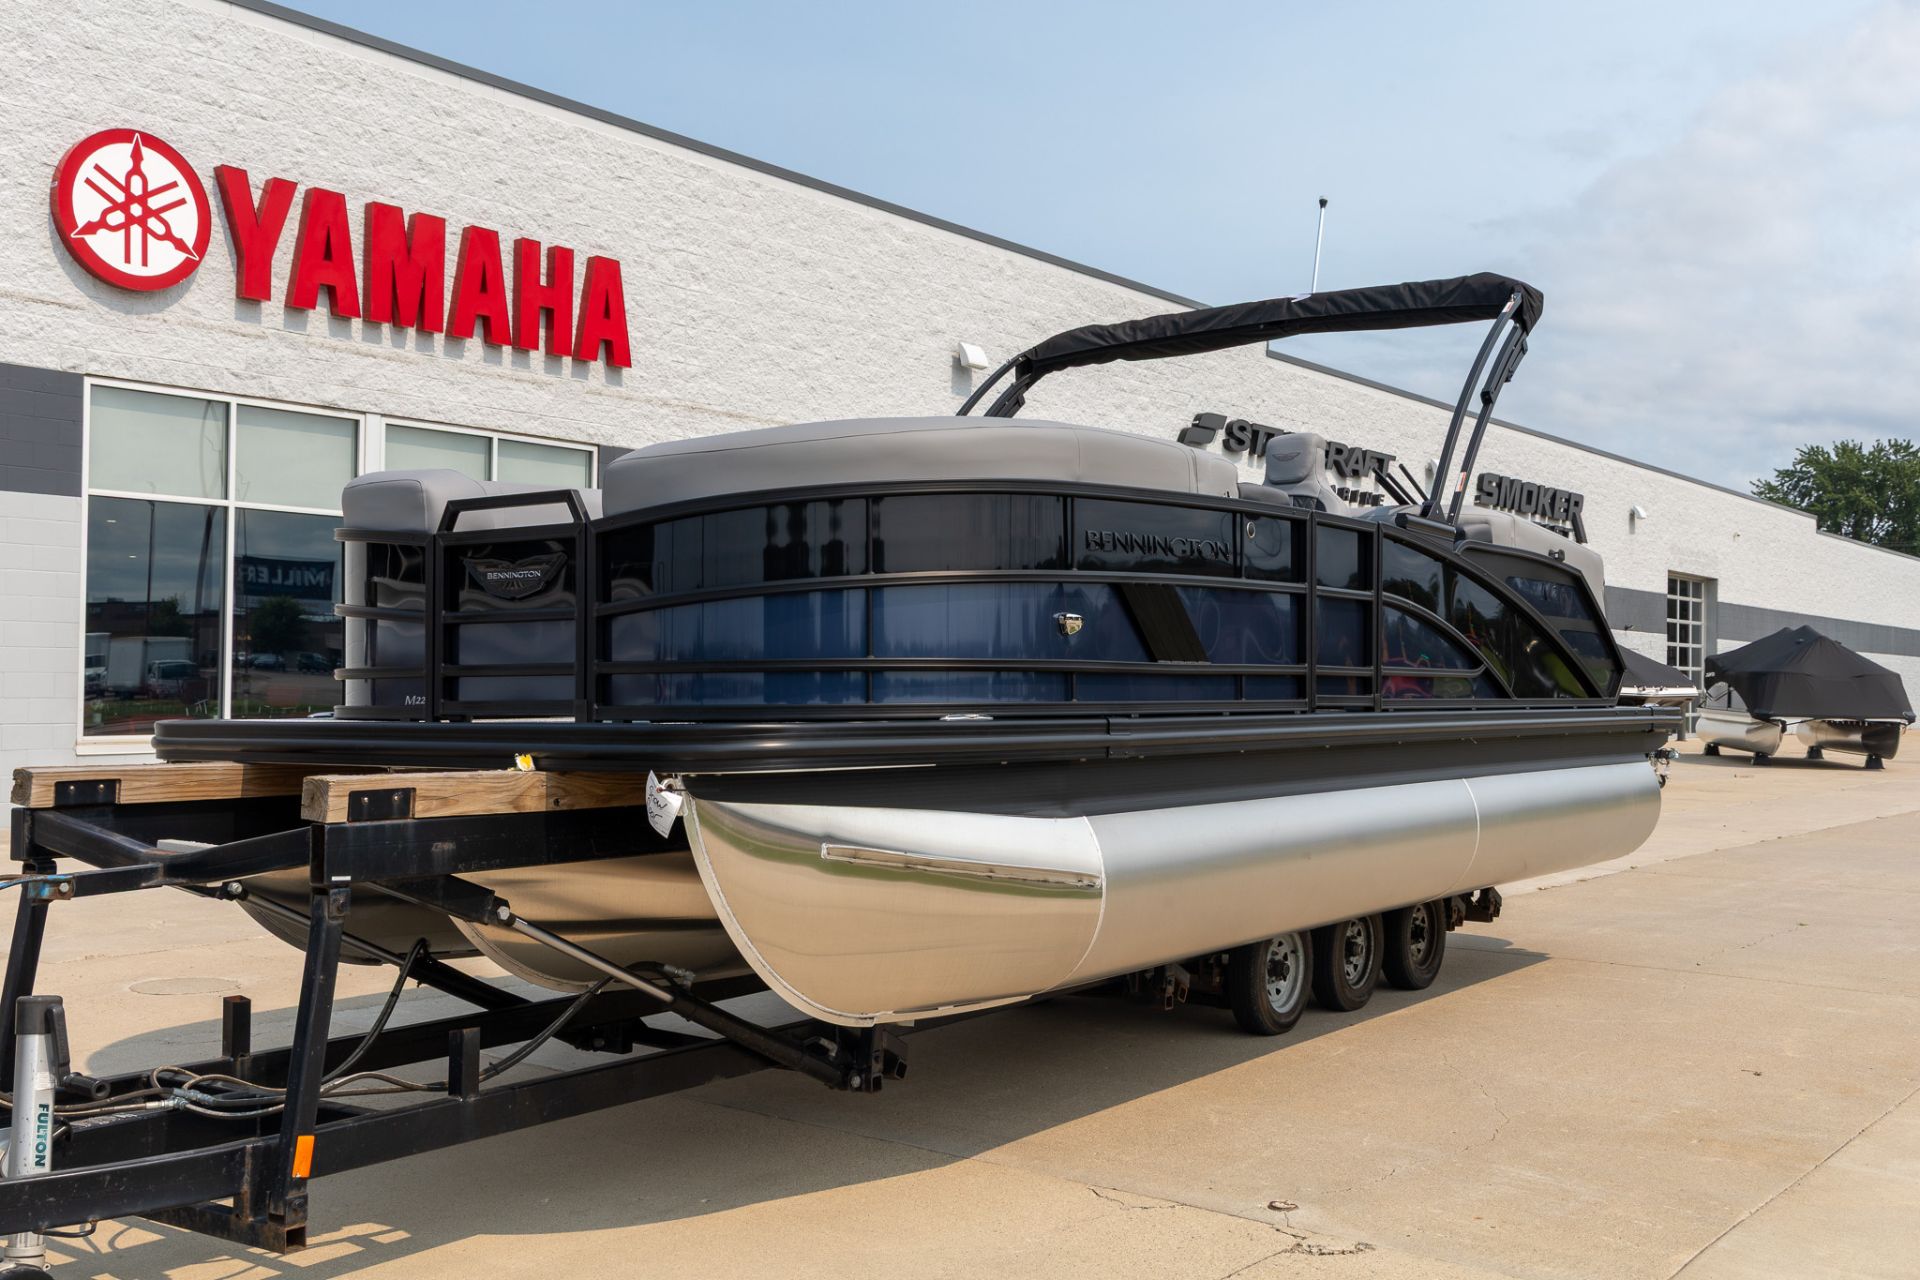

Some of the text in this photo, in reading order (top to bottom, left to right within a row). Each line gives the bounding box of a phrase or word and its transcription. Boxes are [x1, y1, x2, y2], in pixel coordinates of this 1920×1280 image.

[213, 163, 632, 369] YAMAHA
[1222, 418, 1396, 479] STRAFT
[1474, 472, 1588, 544] SMOKER
[487, 570, 541, 580] BENNINGTON
[1085, 530, 1230, 561] BENNINGTON
[34, 1103, 50, 1168] FULTON
